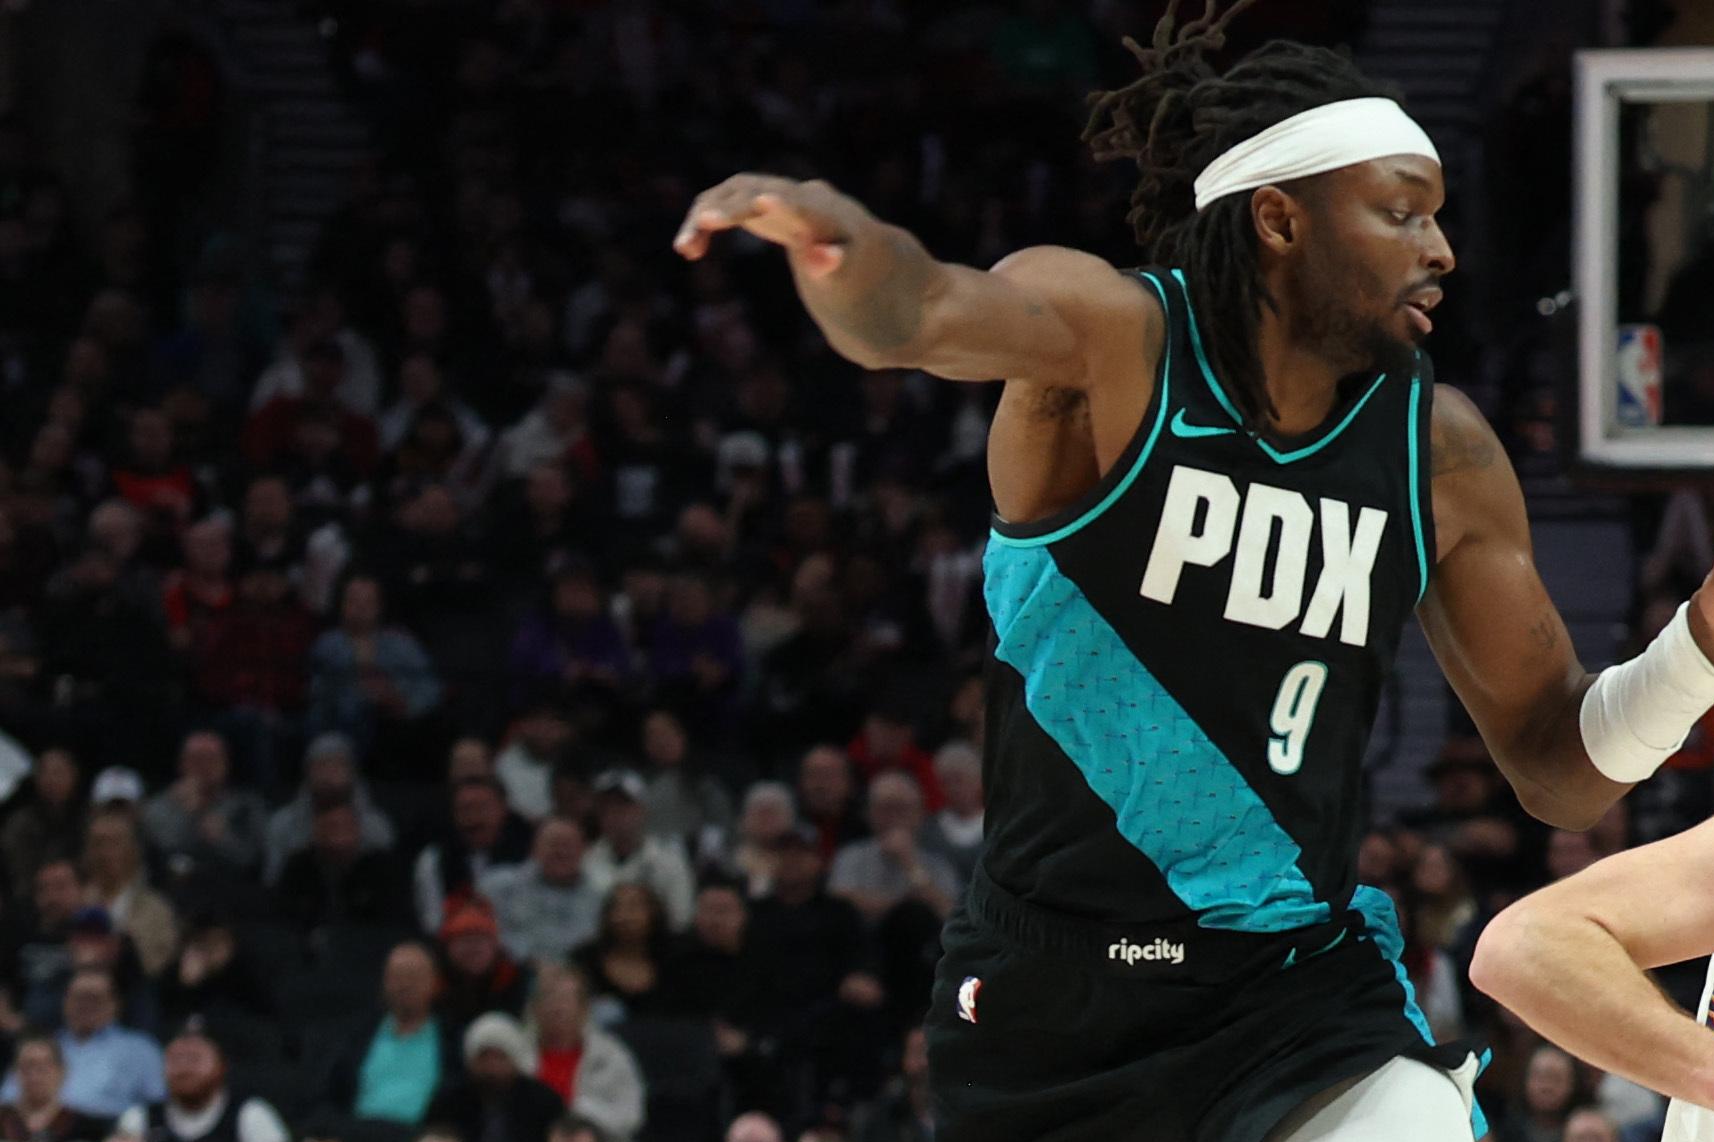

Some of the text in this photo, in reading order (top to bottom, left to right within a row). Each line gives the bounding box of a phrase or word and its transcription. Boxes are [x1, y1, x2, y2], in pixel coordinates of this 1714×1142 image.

[1140, 465, 1388, 647] PDX
[1267, 661, 1328, 775] 9
[1108, 937, 1184, 966] ripcity
